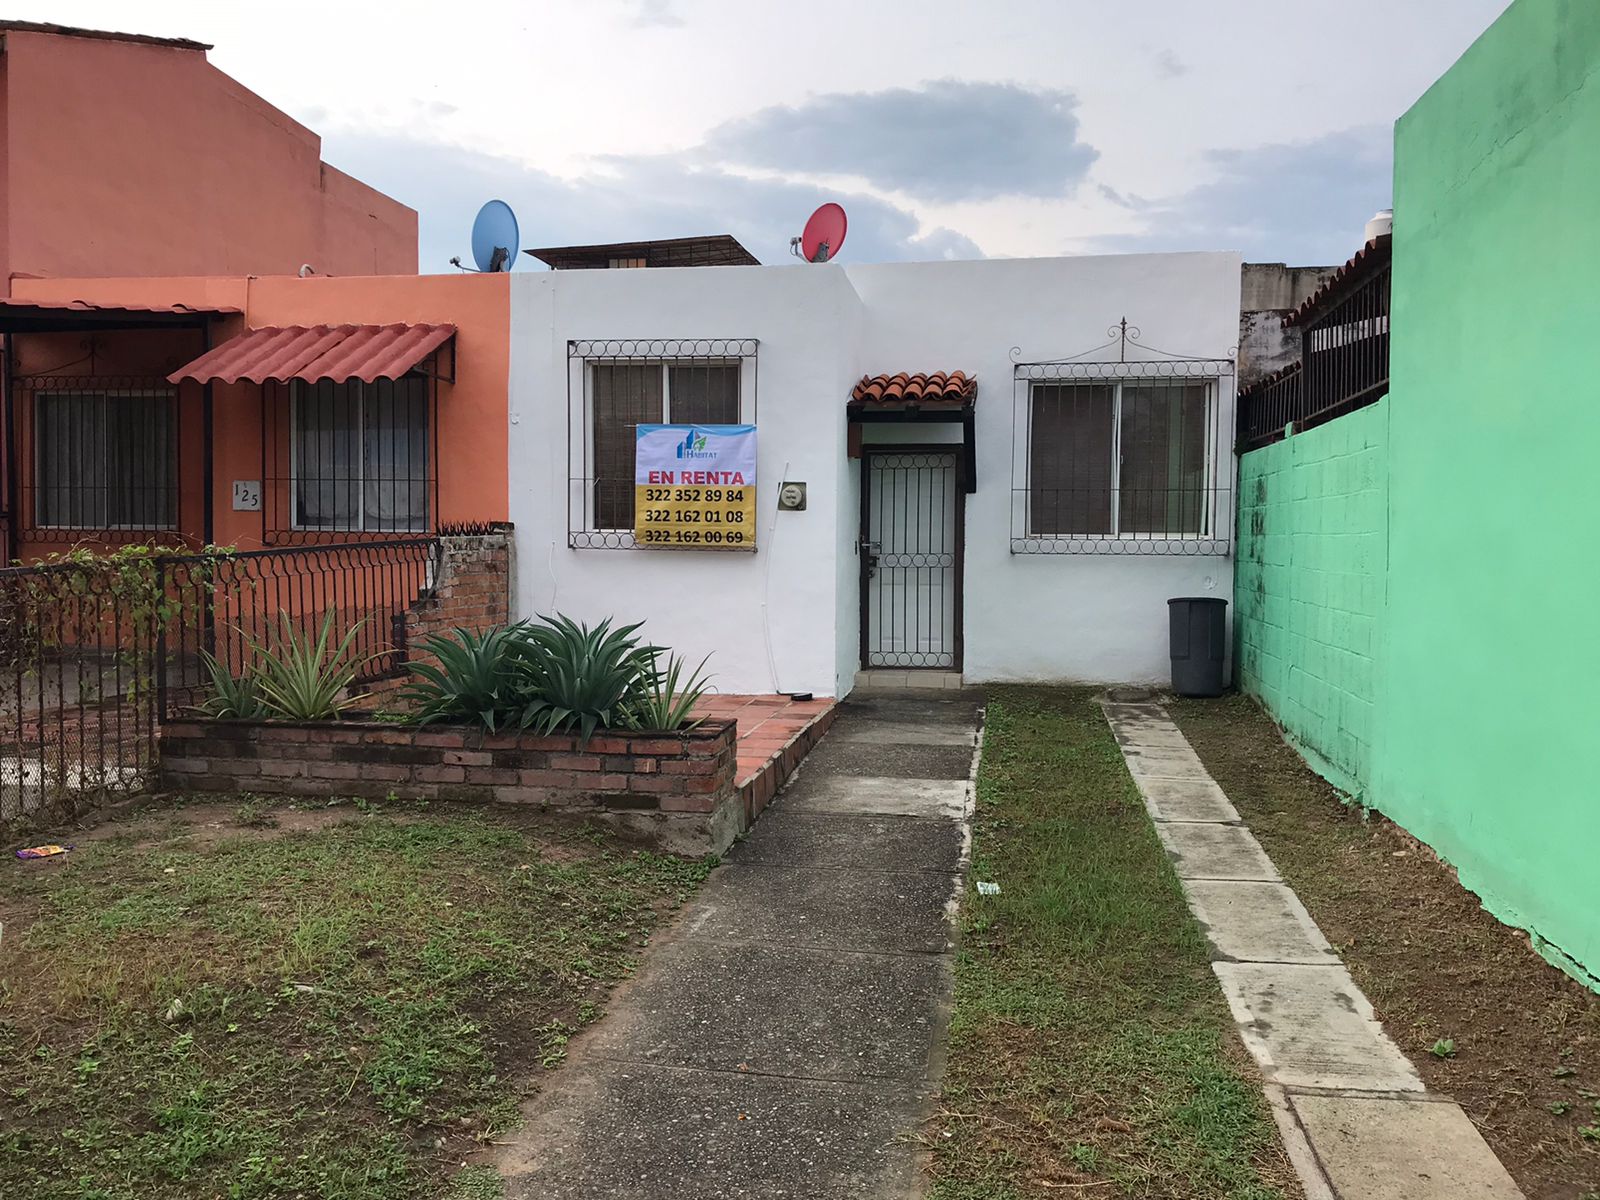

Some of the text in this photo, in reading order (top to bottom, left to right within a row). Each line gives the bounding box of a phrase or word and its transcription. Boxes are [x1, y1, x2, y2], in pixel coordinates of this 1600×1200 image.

[649, 471, 744, 485] EN RENTA
[235, 484, 257, 506] 125
[646, 489, 744, 502] 322 352 89 84
[645, 510, 744, 523] 322 162 01 08
[645, 530, 744, 543] 322 162 00 69
